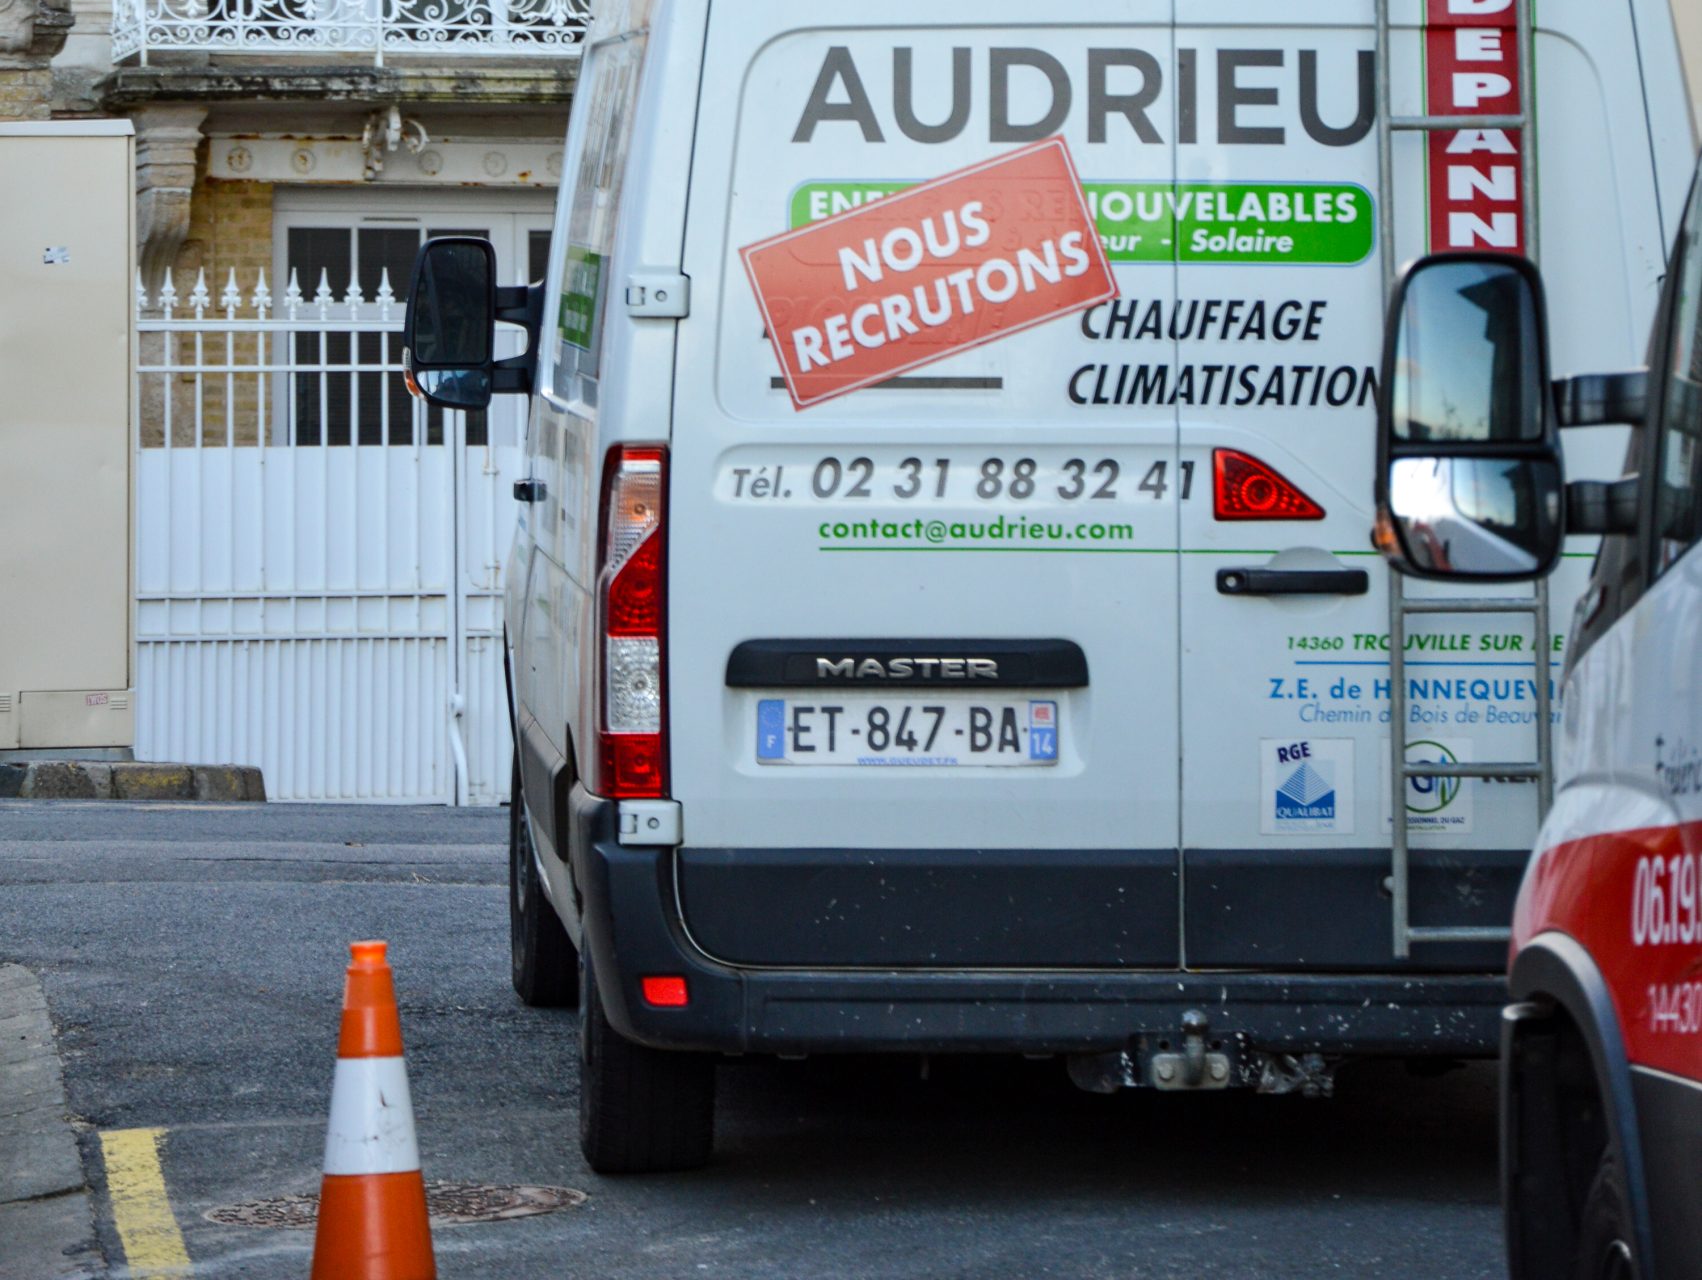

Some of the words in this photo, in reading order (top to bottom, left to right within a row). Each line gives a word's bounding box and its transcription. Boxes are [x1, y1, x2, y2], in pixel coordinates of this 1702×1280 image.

[791, 46, 1376, 147] AUDRIEU
[838, 201, 990, 291] NOUS
[1190, 227, 1294, 253] Solaire
[792, 231, 1089, 372] RECRUTONS
[1081, 299, 1327, 341] CHAUFFAGE
[733, 466, 792, 498] Tél.
[812, 456, 874, 499] 02
[893, 456, 950, 499] 31
[976, 457, 1037, 500] 88
[1057, 458, 1120, 500] 32
[1138, 460, 1195, 500] 41
[818, 515, 1133, 543] contact@audrieu.com
[1287, 636, 1344, 651] 14360
[1479, 634, 1523, 651] SUR
[816, 657, 998, 679] MASTER
[1269, 678, 1318, 700] Z.E.
[1330, 677, 1362, 700] de
[1300, 702, 1372, 723] Chemin
[1409, 704, 1449, 724] Bois
[1454, 702, 1480, 724] de
[1033, 733, 1054, 755] 14
[1277, 741, 1311, 763] RGE
[1276, 806, 1334, 819] QUALIBAT
[1632, 854, 1702, 946] 06.19.
